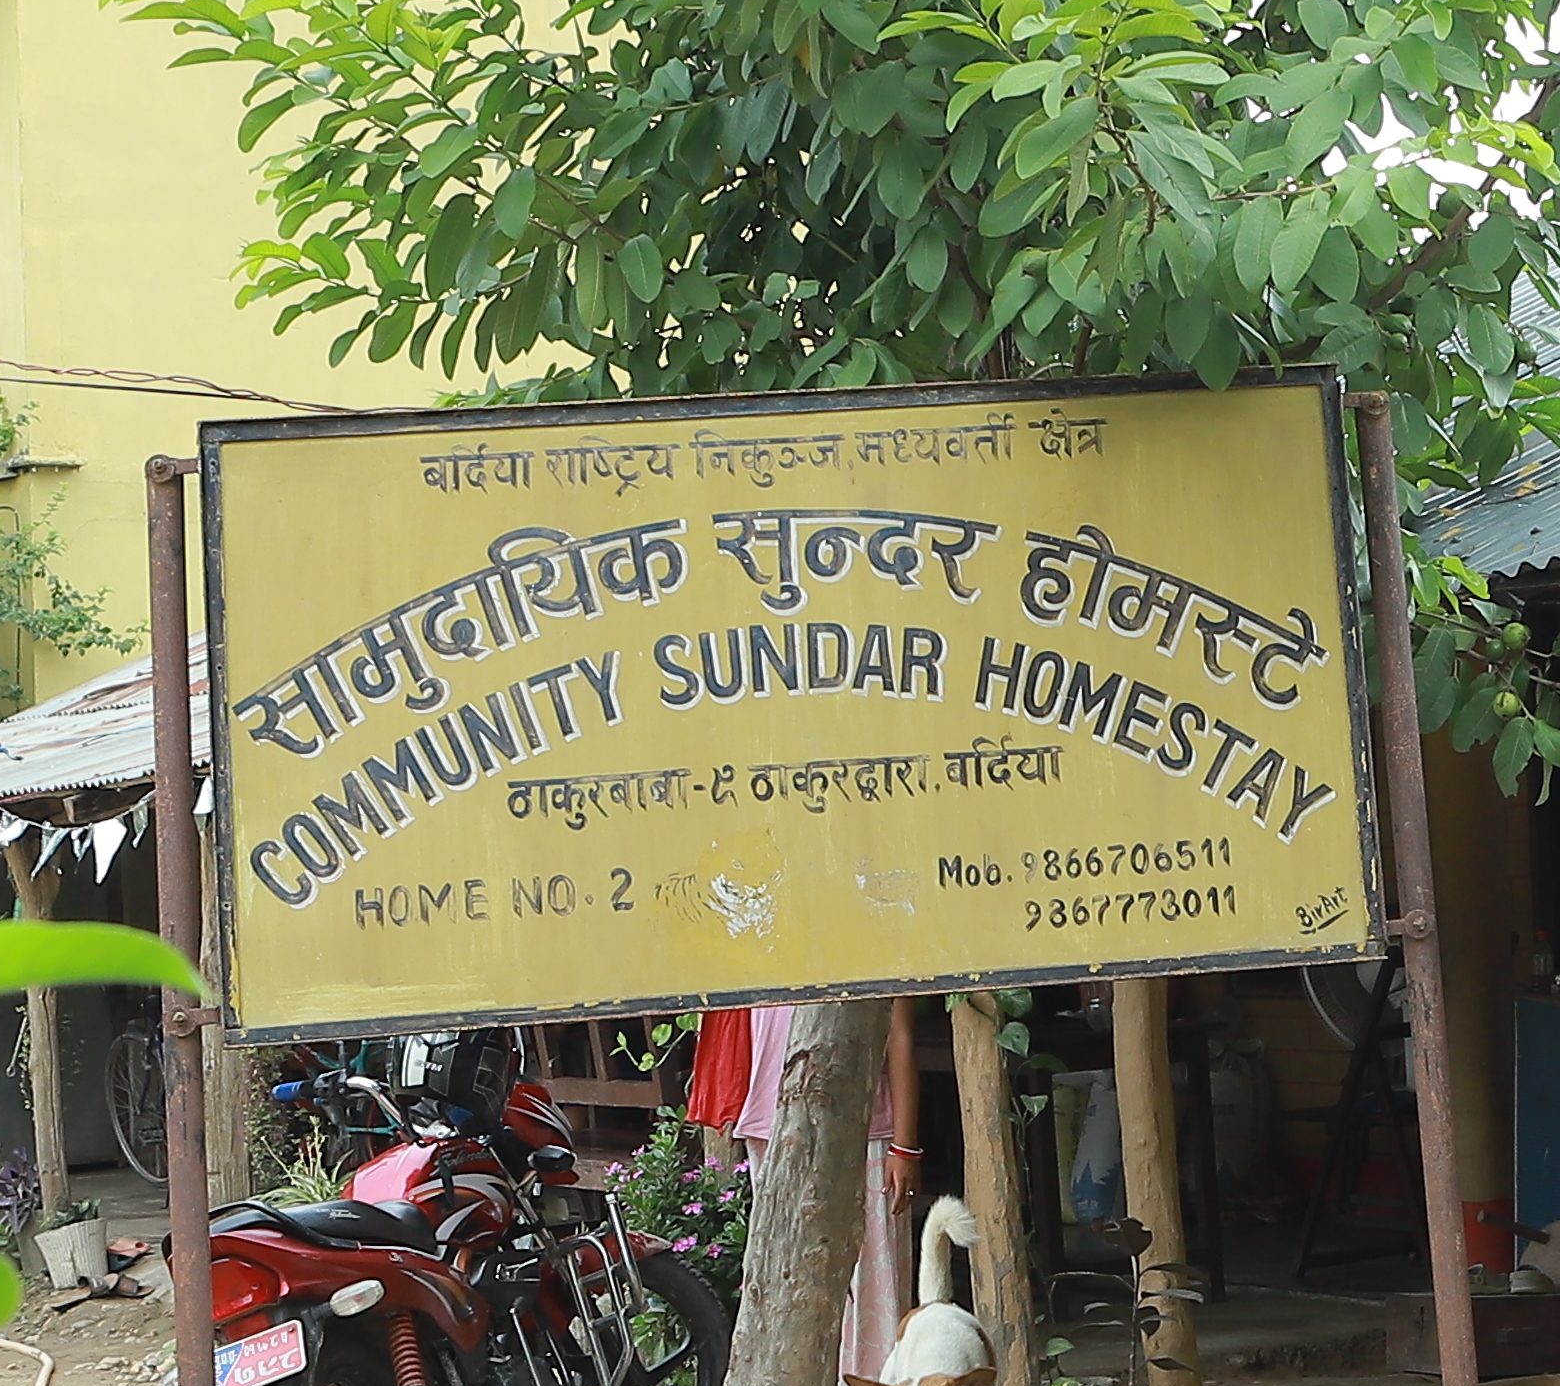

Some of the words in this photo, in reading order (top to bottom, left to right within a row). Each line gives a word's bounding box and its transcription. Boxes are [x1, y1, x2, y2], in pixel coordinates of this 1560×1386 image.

[420, 443, 535, 494] बर्दिया
[1028, 408, 1107, 459] क्षेत्र
[233, 517, 686, 758] सामुदायिक
[712, 509, 1002, 616] सुन्दर
[1021, 524, 1330, 710] होमस्टे
[250, 650, 621, 909] COMMUNITY
[653, 622, 948, 711] SUNDAR
[973, 636, 1337, 844] HOMESTAY
[944, 734, 1065, 792] बर्दिया
[938, 853, 1013, 890] Mob.
[1020, 836, 1232, 884] 9866706511
[354, 878, 490, 930] HOME
[609, 867, 635, 913] 2
[1023, 884, 1237, 933] 9867773011
